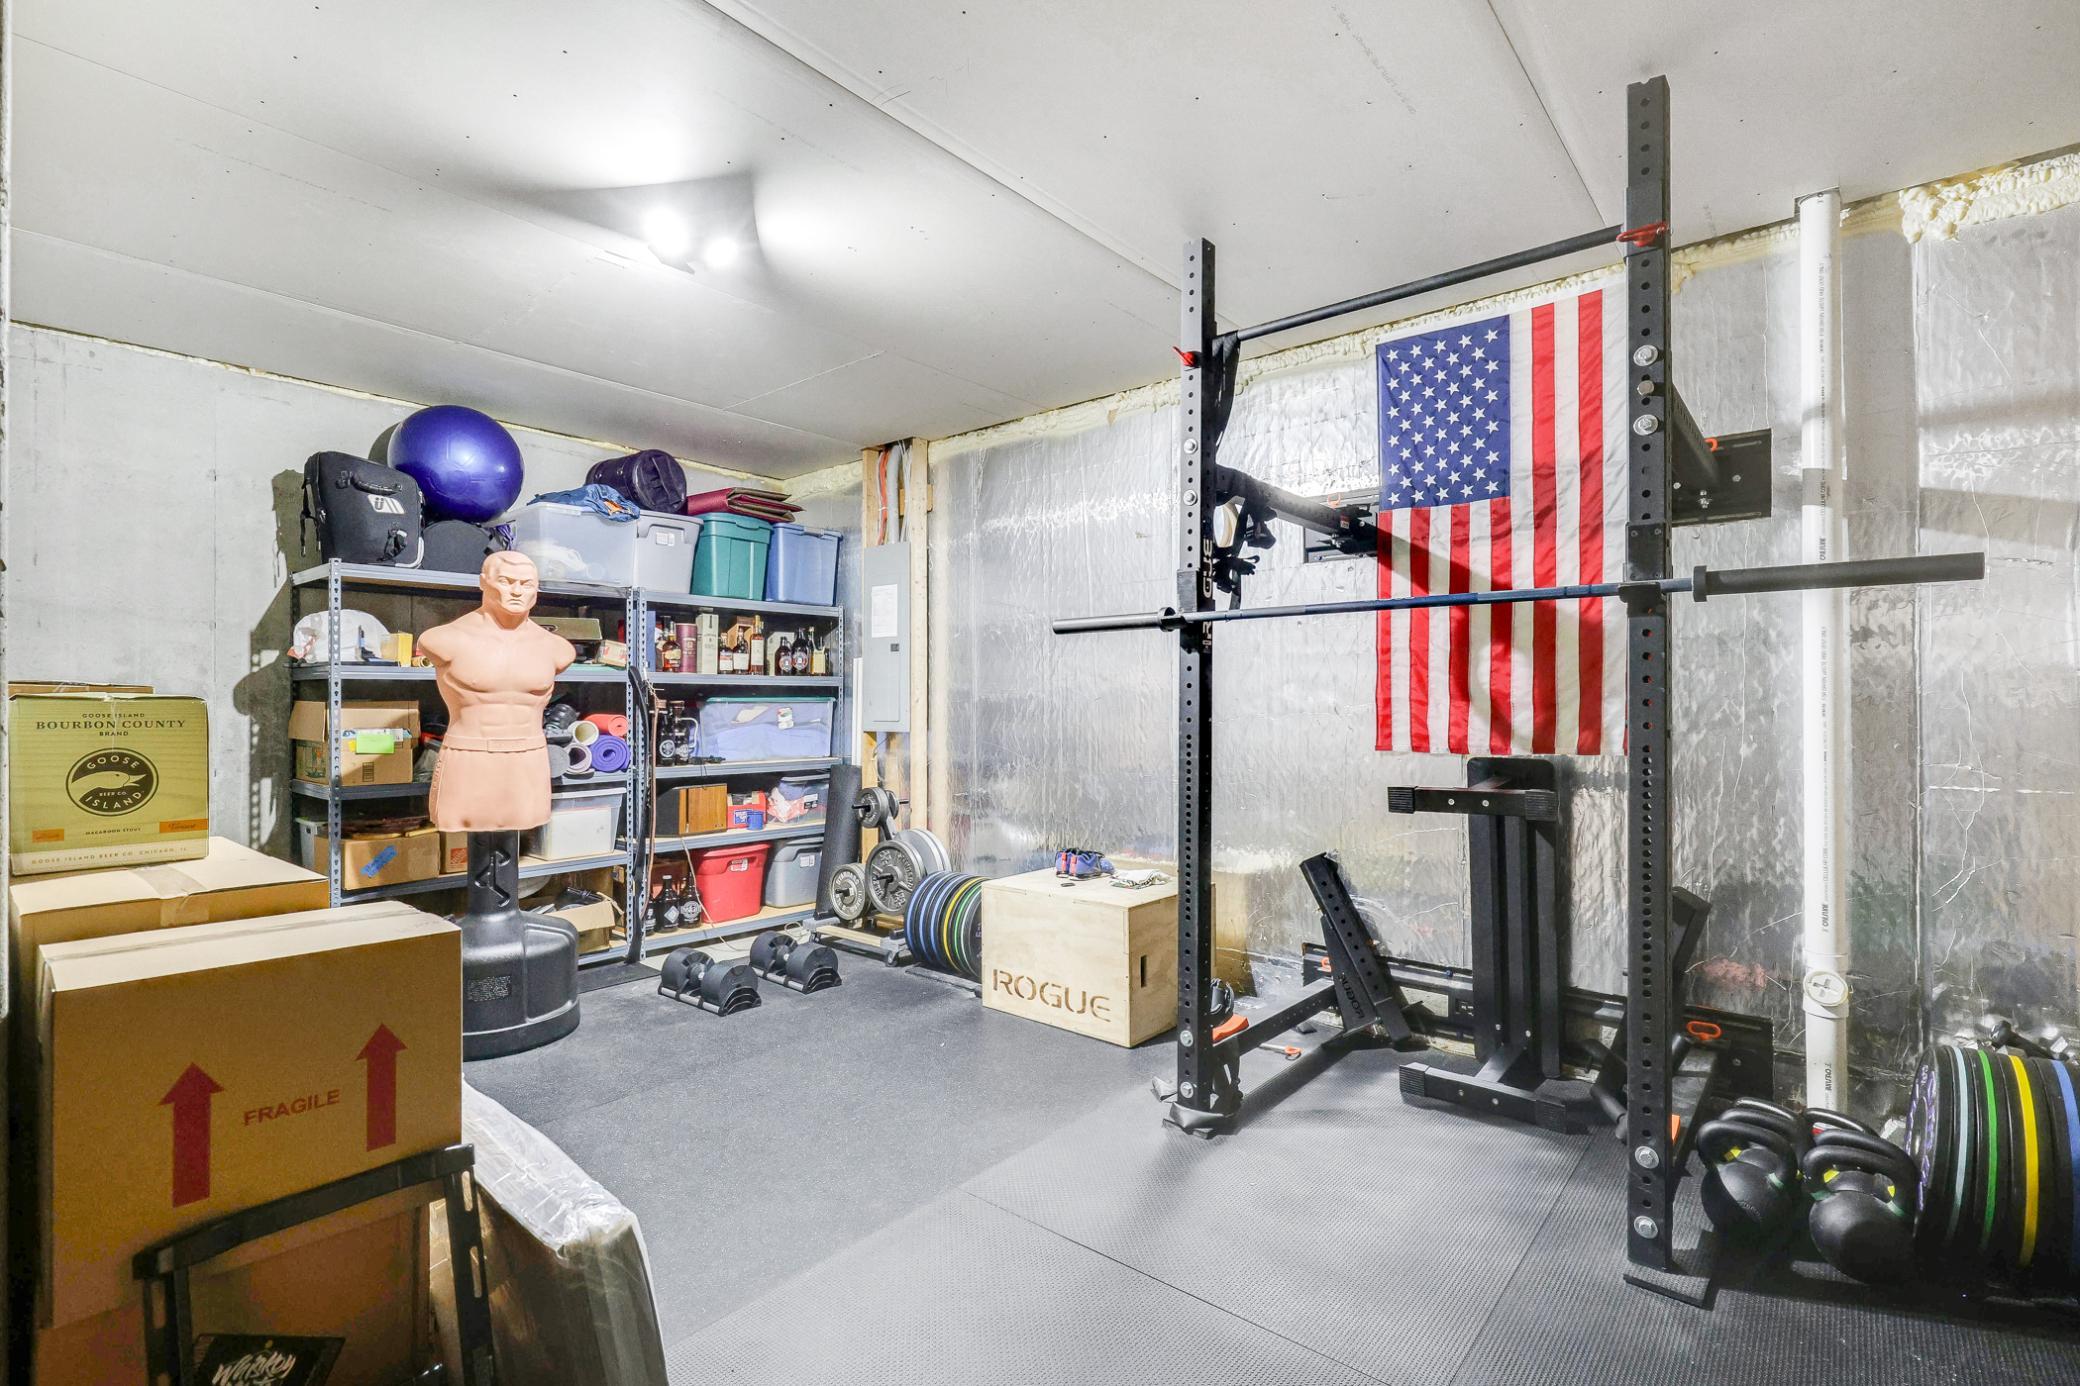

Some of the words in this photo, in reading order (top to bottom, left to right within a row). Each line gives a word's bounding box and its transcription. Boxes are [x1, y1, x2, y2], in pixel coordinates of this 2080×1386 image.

[36, 720, 117, 730] BOURBON
[122, 719, 186, 729] COUNTY
[86, 755, 140, 770] GOOSE
[85, 792, 142, 809] ISLAND
[992, 968, 1112, 1023] ROGUE
[243, 1088, 341, 1127] FRAGILE
